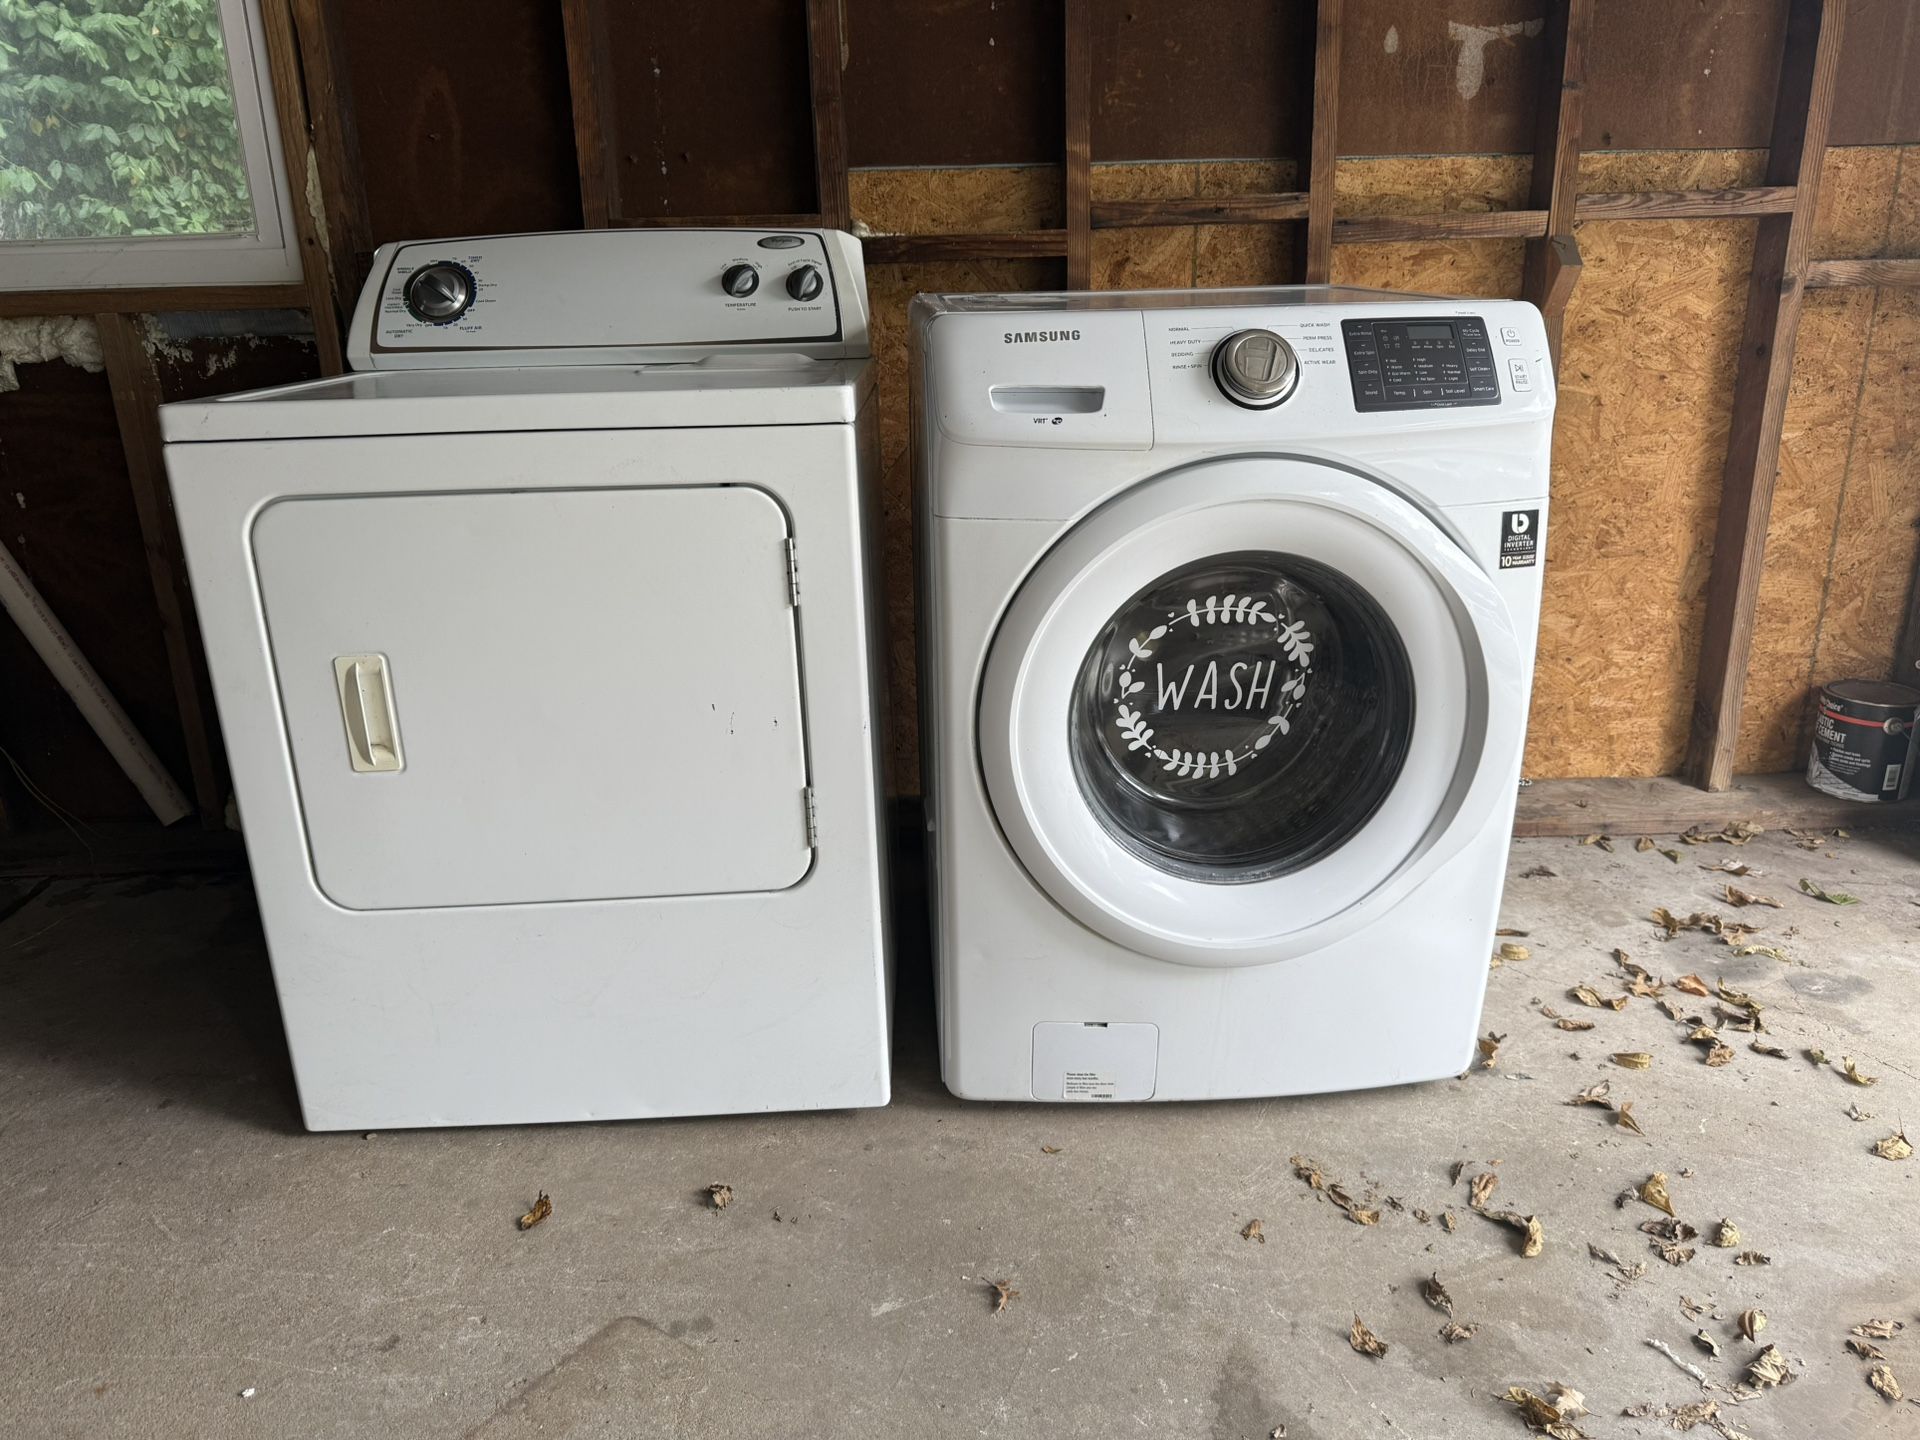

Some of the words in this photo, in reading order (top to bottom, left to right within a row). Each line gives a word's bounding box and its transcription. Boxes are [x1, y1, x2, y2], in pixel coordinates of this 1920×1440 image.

[1004, 330, 1081, 344] SAMSUNG
[1504, 540, 1534, 548] INVERTER
[1508, 534, 1531, 542] DIGITAL
[1502, 556, 1512, 567] 10
[1157, 660, 1276, 711] WASH
[1820, 725, 1847, 743] CEMENT
